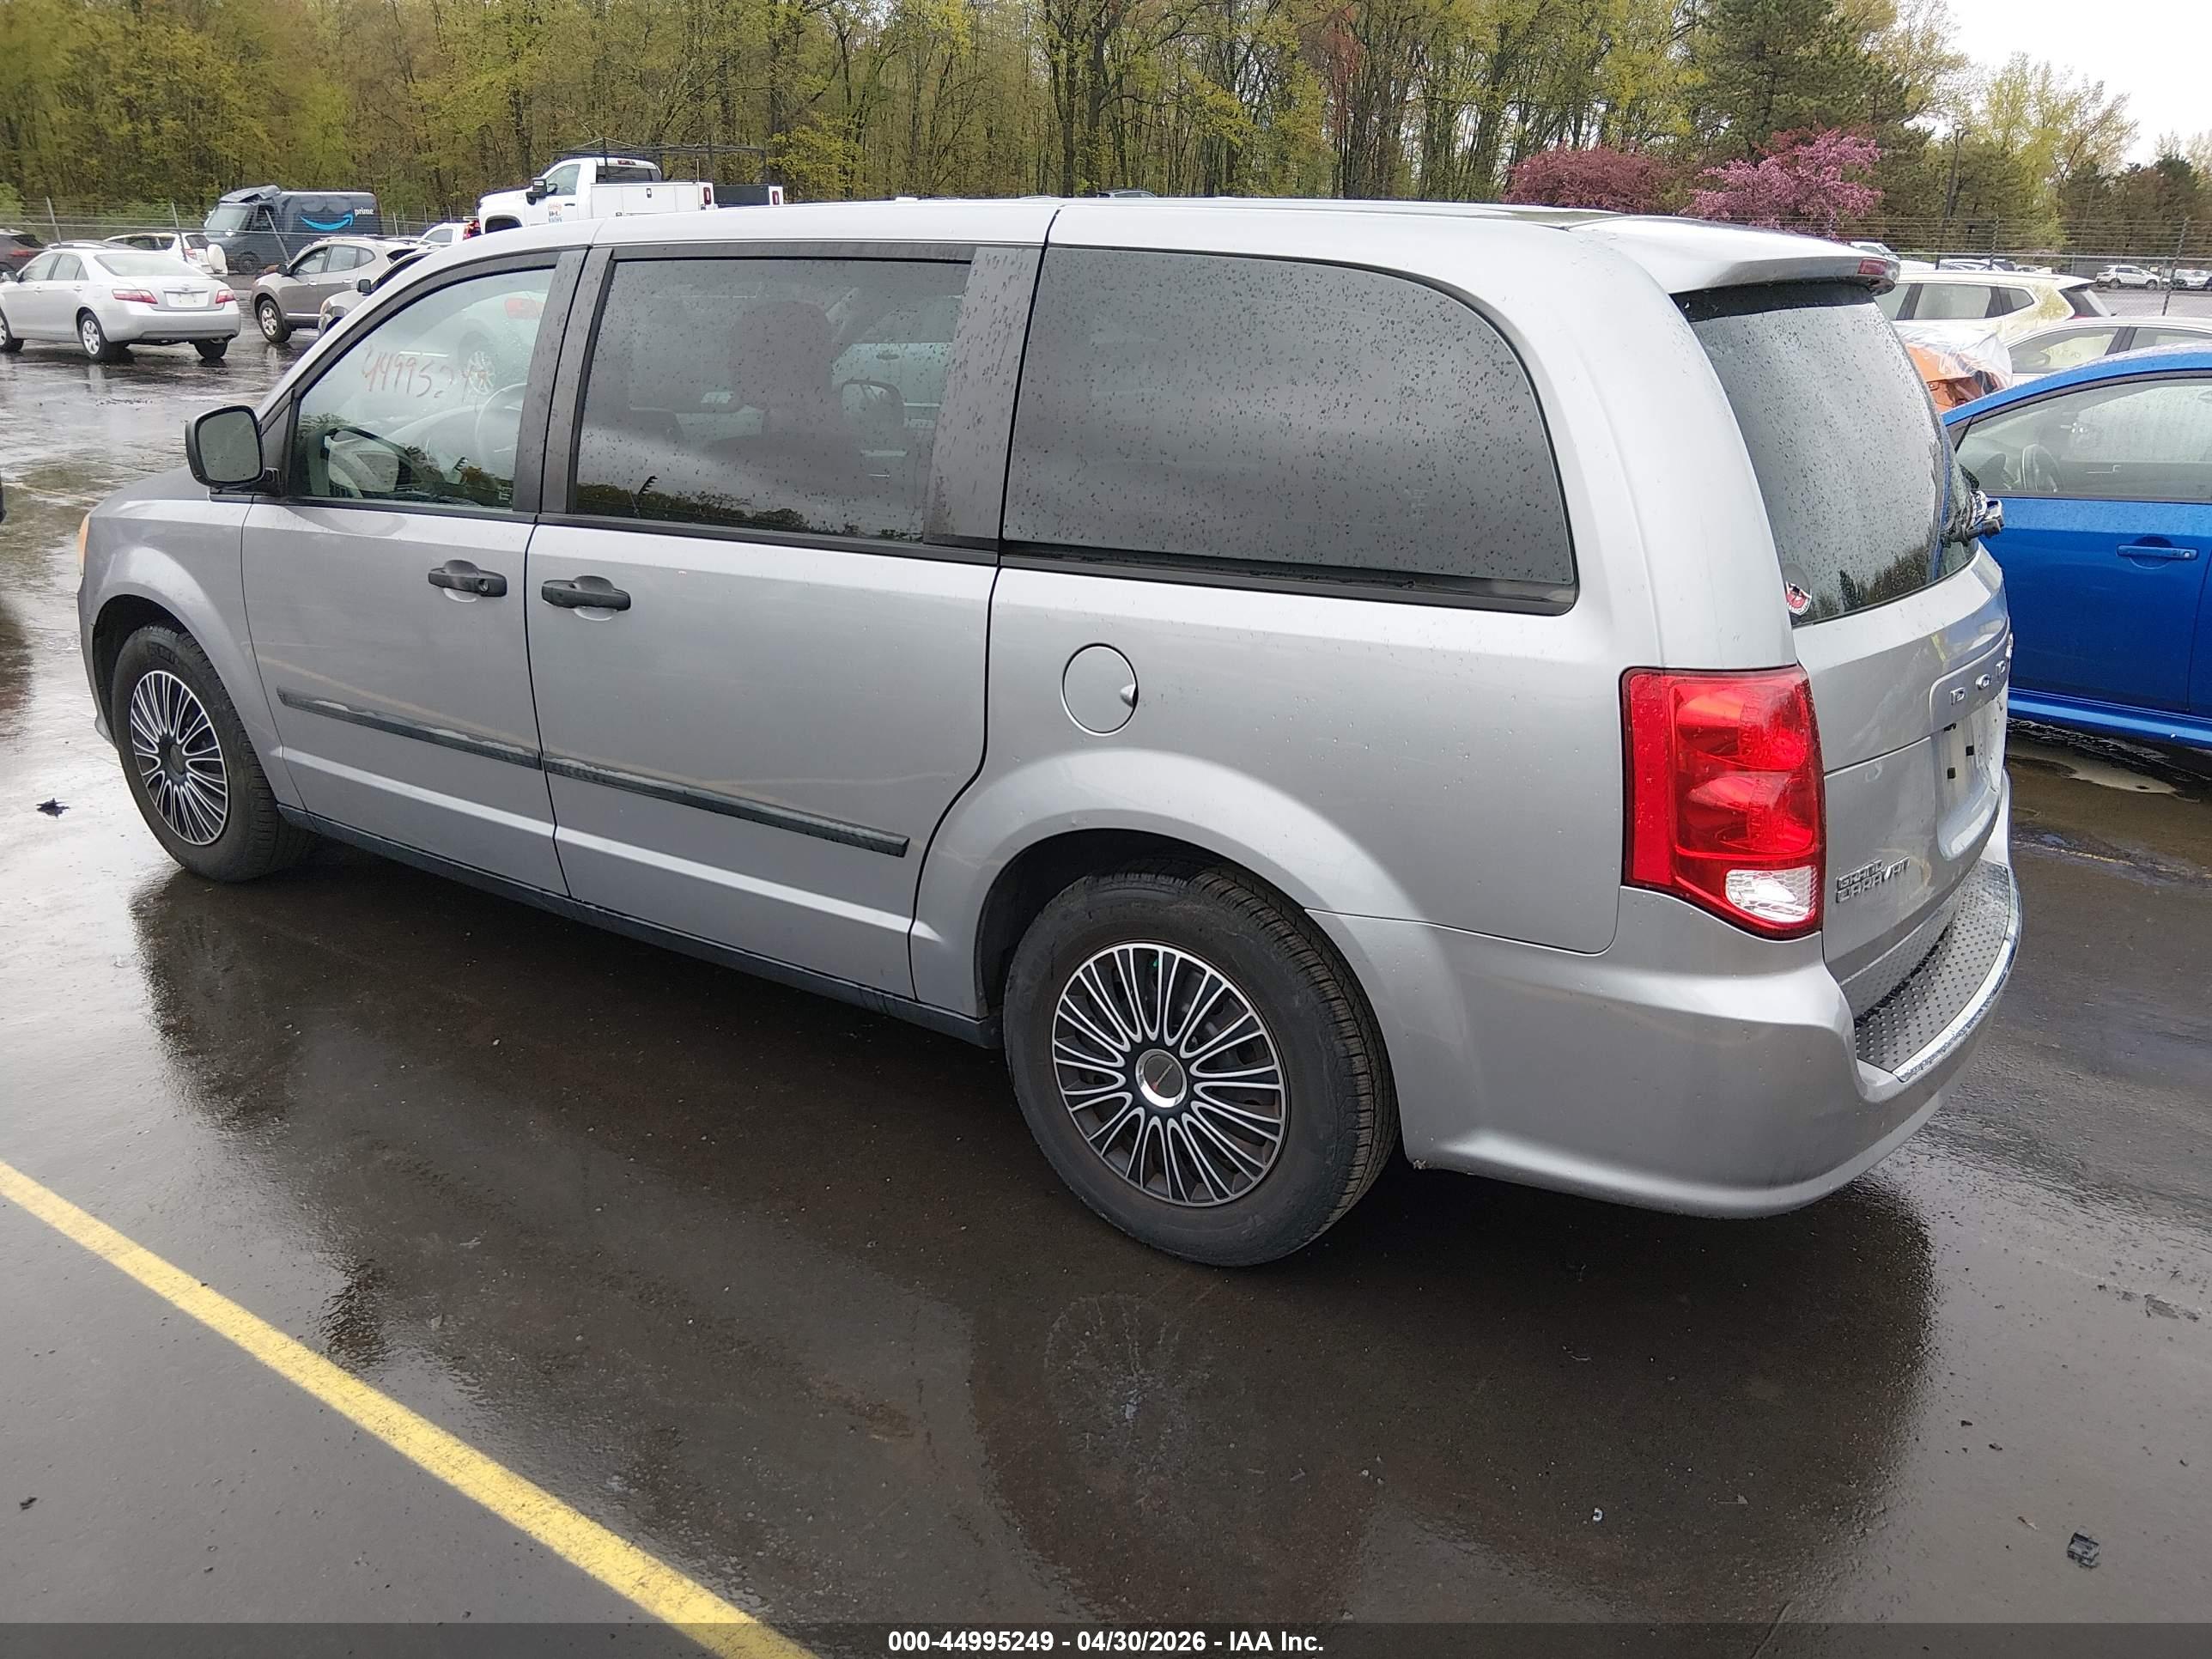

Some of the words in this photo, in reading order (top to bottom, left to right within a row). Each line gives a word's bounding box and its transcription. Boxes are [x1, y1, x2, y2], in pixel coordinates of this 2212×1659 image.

[354, 206, 374, 216] prime
[1949, 632, 2014, 705] DOD
[1835, 855, 1911, 903] CARAVAN
[1836, 859, 1883, 890] GRAND
